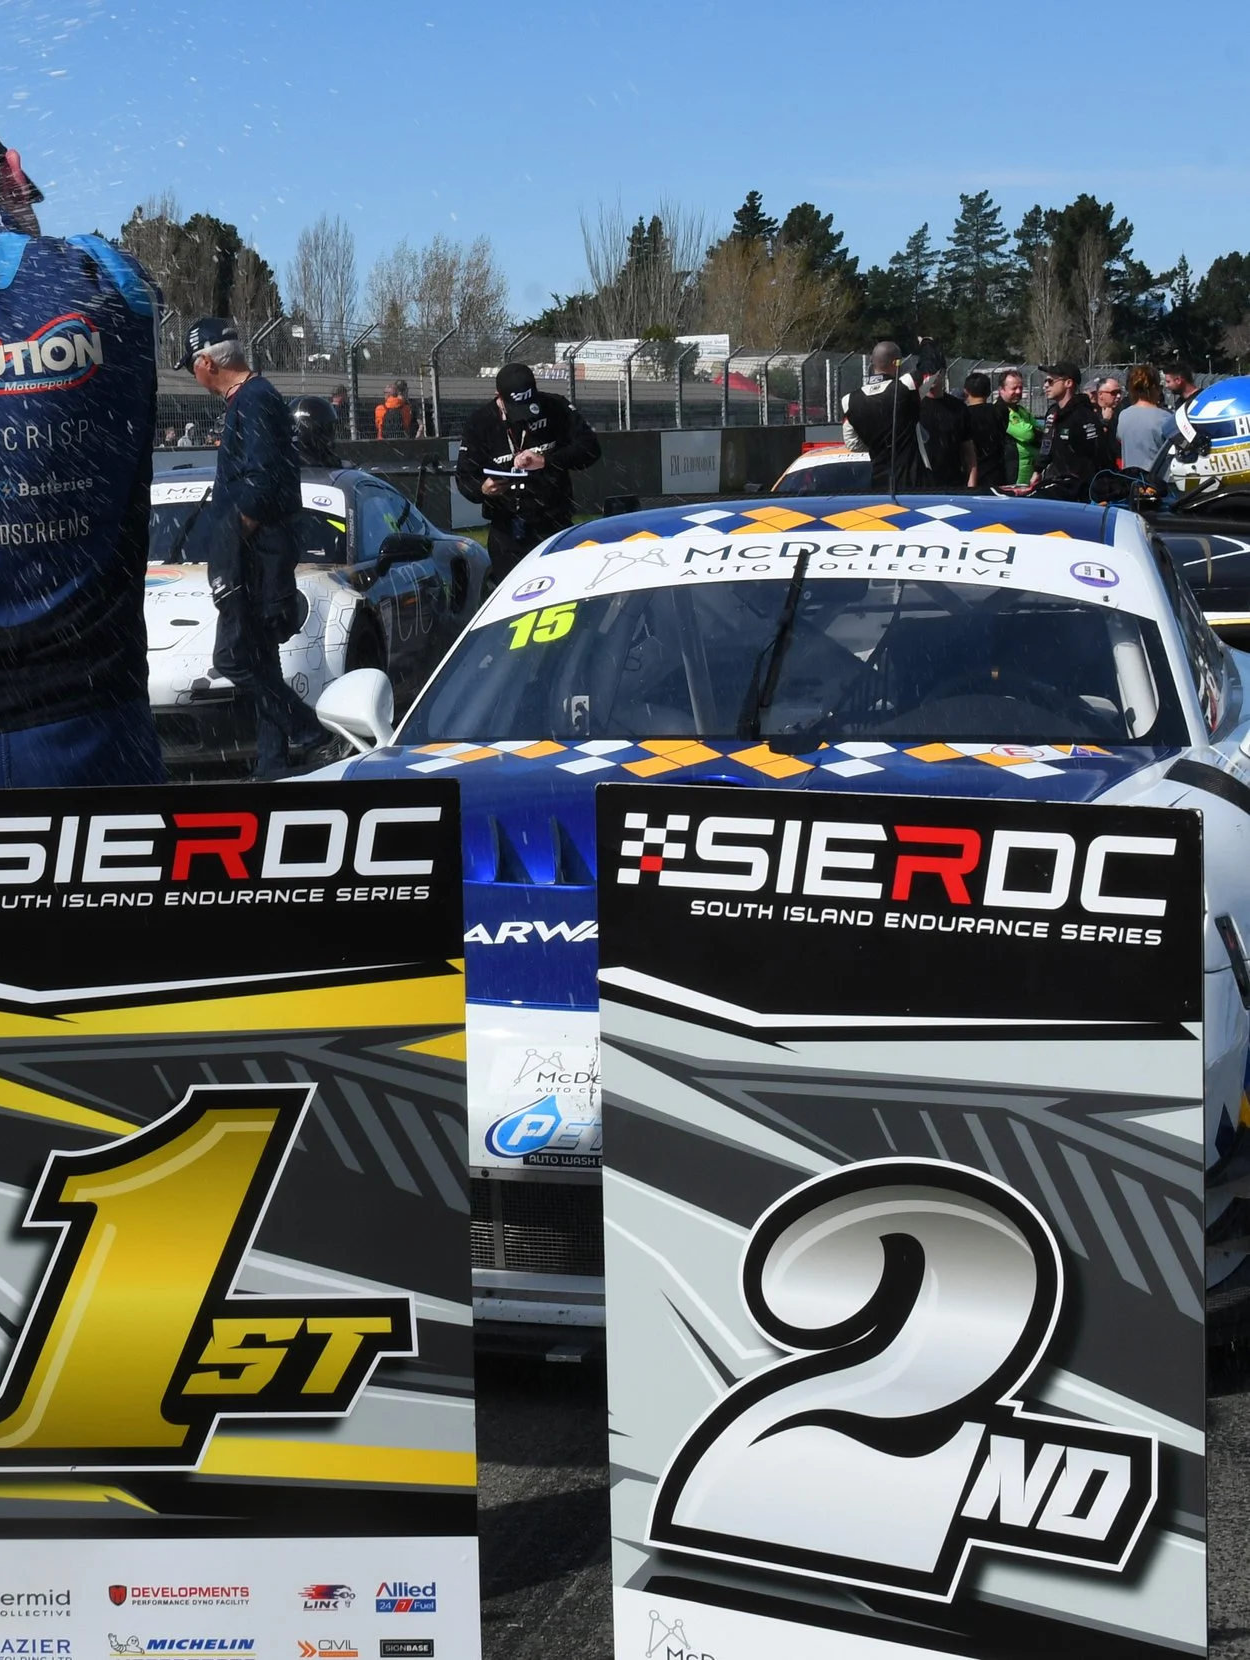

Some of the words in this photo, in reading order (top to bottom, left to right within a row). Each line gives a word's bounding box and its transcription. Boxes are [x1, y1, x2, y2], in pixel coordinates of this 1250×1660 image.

[4, 375, 74, 392] Motorsport
[18, 477, 94, 497] Batteries
[684, 541, 1017, 565] McDermid
[681, 564, 771, 576] AUTO
[801, 562, 1012, 580] OLLECTIVE
[508, 602, 578, 650] 15
[658, 816, 1178, 917] SIERDC
[61, 891, 153, 908] ISLAND
[164, 888, 325, 906] ENDURANCE
[335, 885, 431, 903] SERIES
[690, 900, 773, 920] SOUTH
[782, 905, 874, 927] ISLAND
[883, 911, 1049, 939] ENDURANCE
[1060, 923, 1163, 946] SERIES
[528, 1154, 559, 1164] AUTO
[561, 1155, 596, 1165] WASH
[131, 1586, 250, 1598] DEVELOPMENTS
[376, 1581, 437, 1598] Allied
[414, 1601, 435, 1610] Fuel
[146, 1638, 255, 1651] MICHELIN
[318, 1639, 358, 1650] CIVIL
[384, 1643, 429, 1653] SIGNBASE
